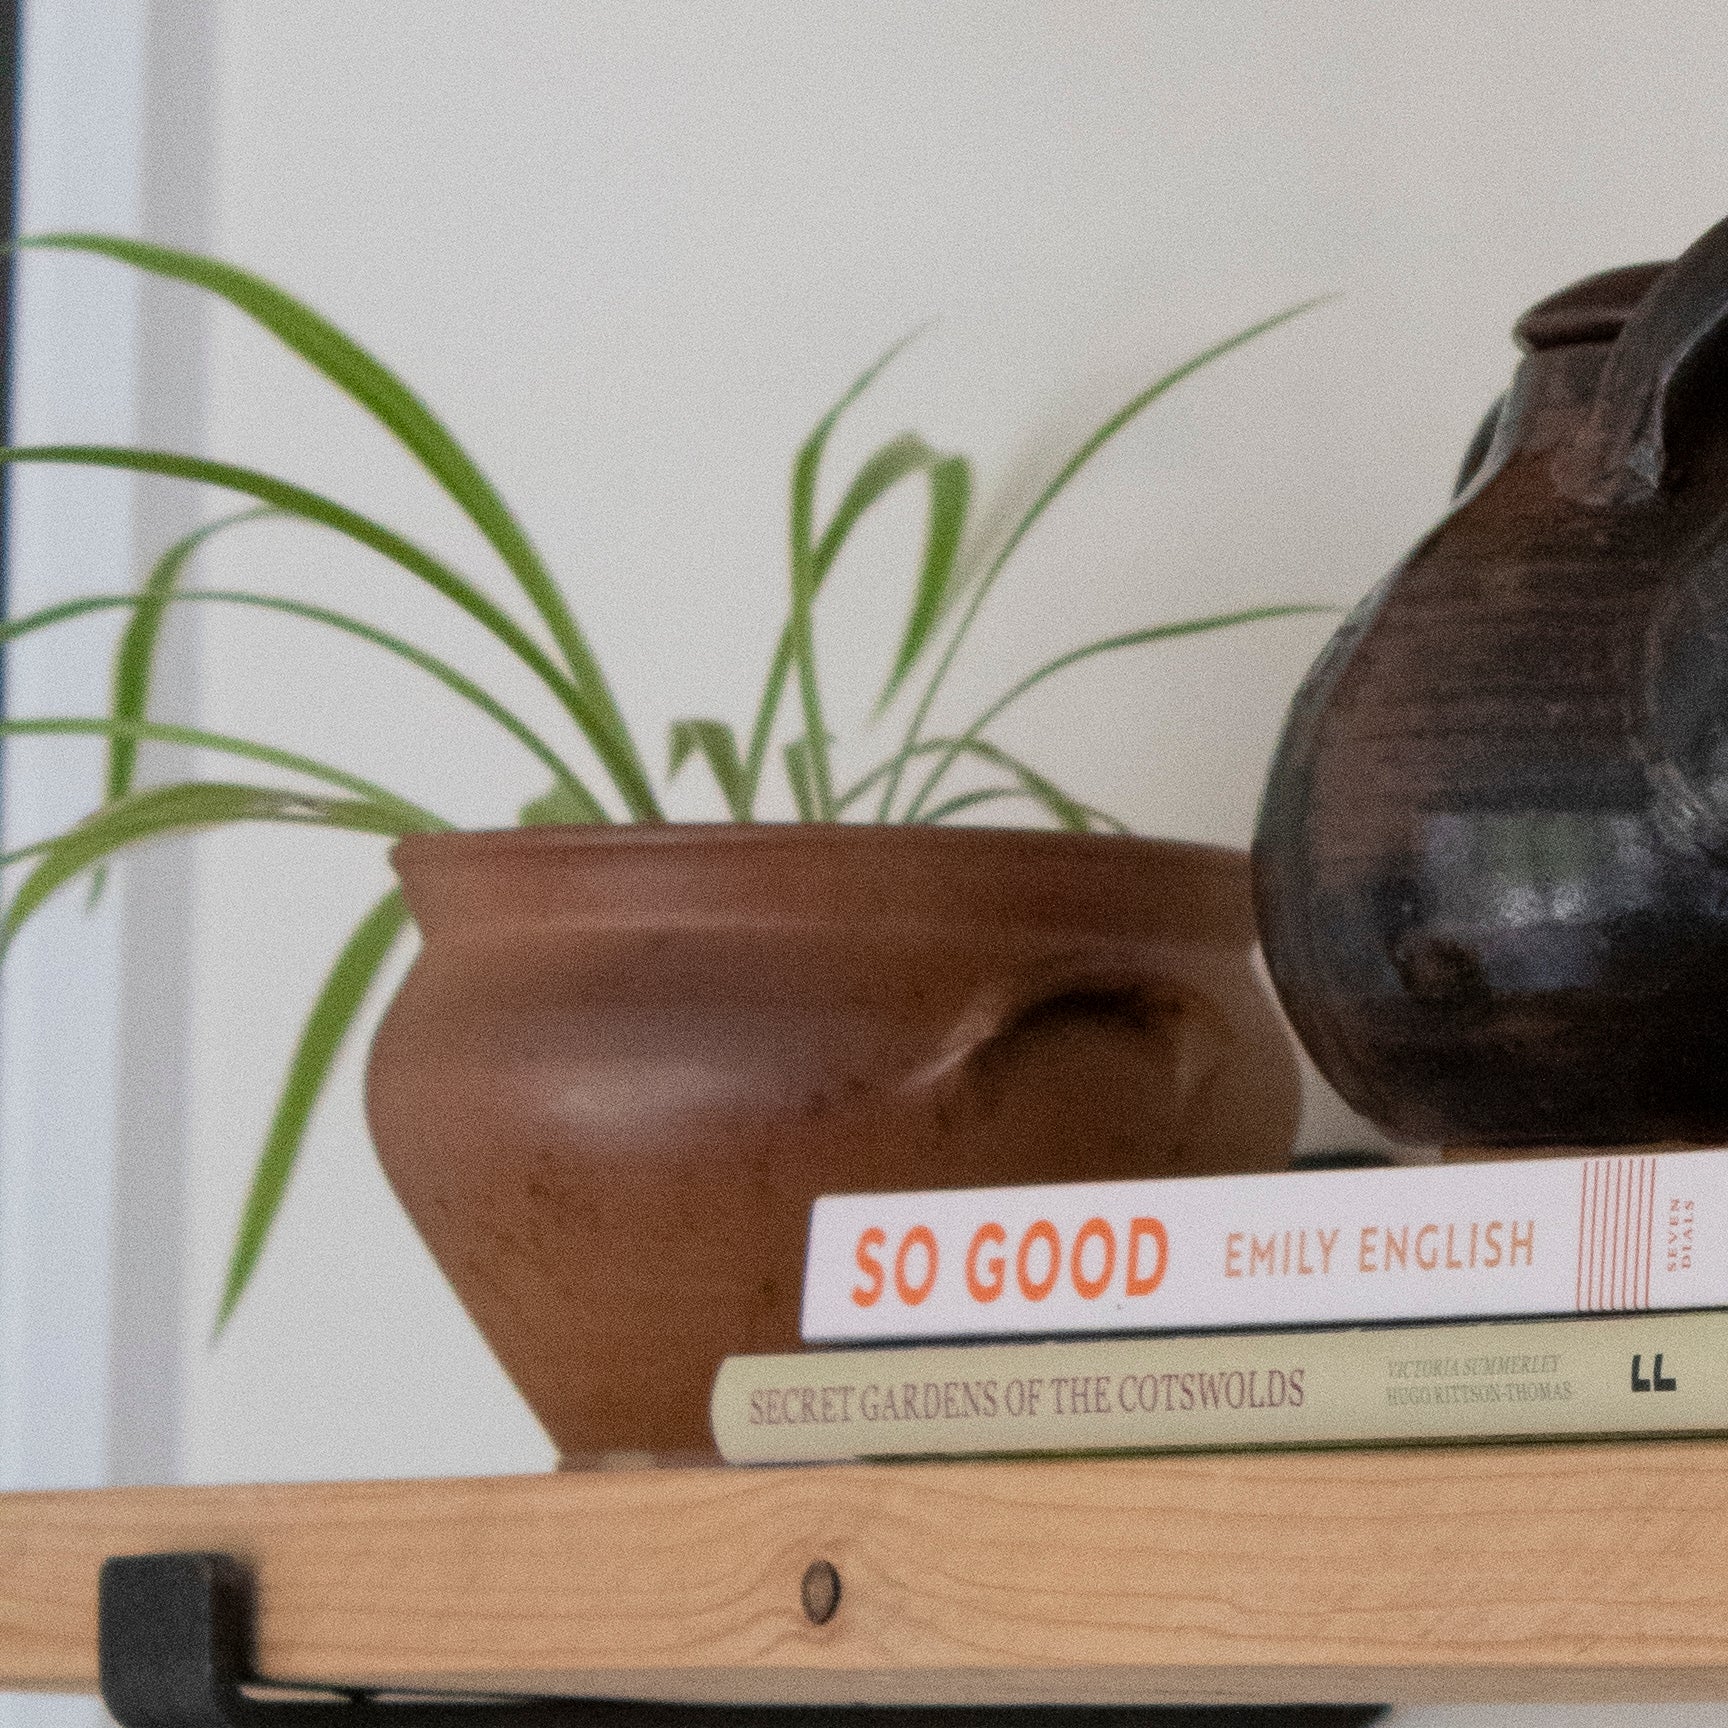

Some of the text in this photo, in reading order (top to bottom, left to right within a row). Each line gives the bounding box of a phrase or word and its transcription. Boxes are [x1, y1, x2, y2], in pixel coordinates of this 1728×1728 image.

[851, 1216, 1170, 1308] SO GOOD
[1223, 1220, 1537, 1278] EMILY ENGLISH
[1666, 1198, 1680, 1272] SEVEN
[1681, 1200, 1695, 1270] DIALS
[748, 1368, 1306, 1425] SECRET GARDENS OF THE COTSWOLDS
